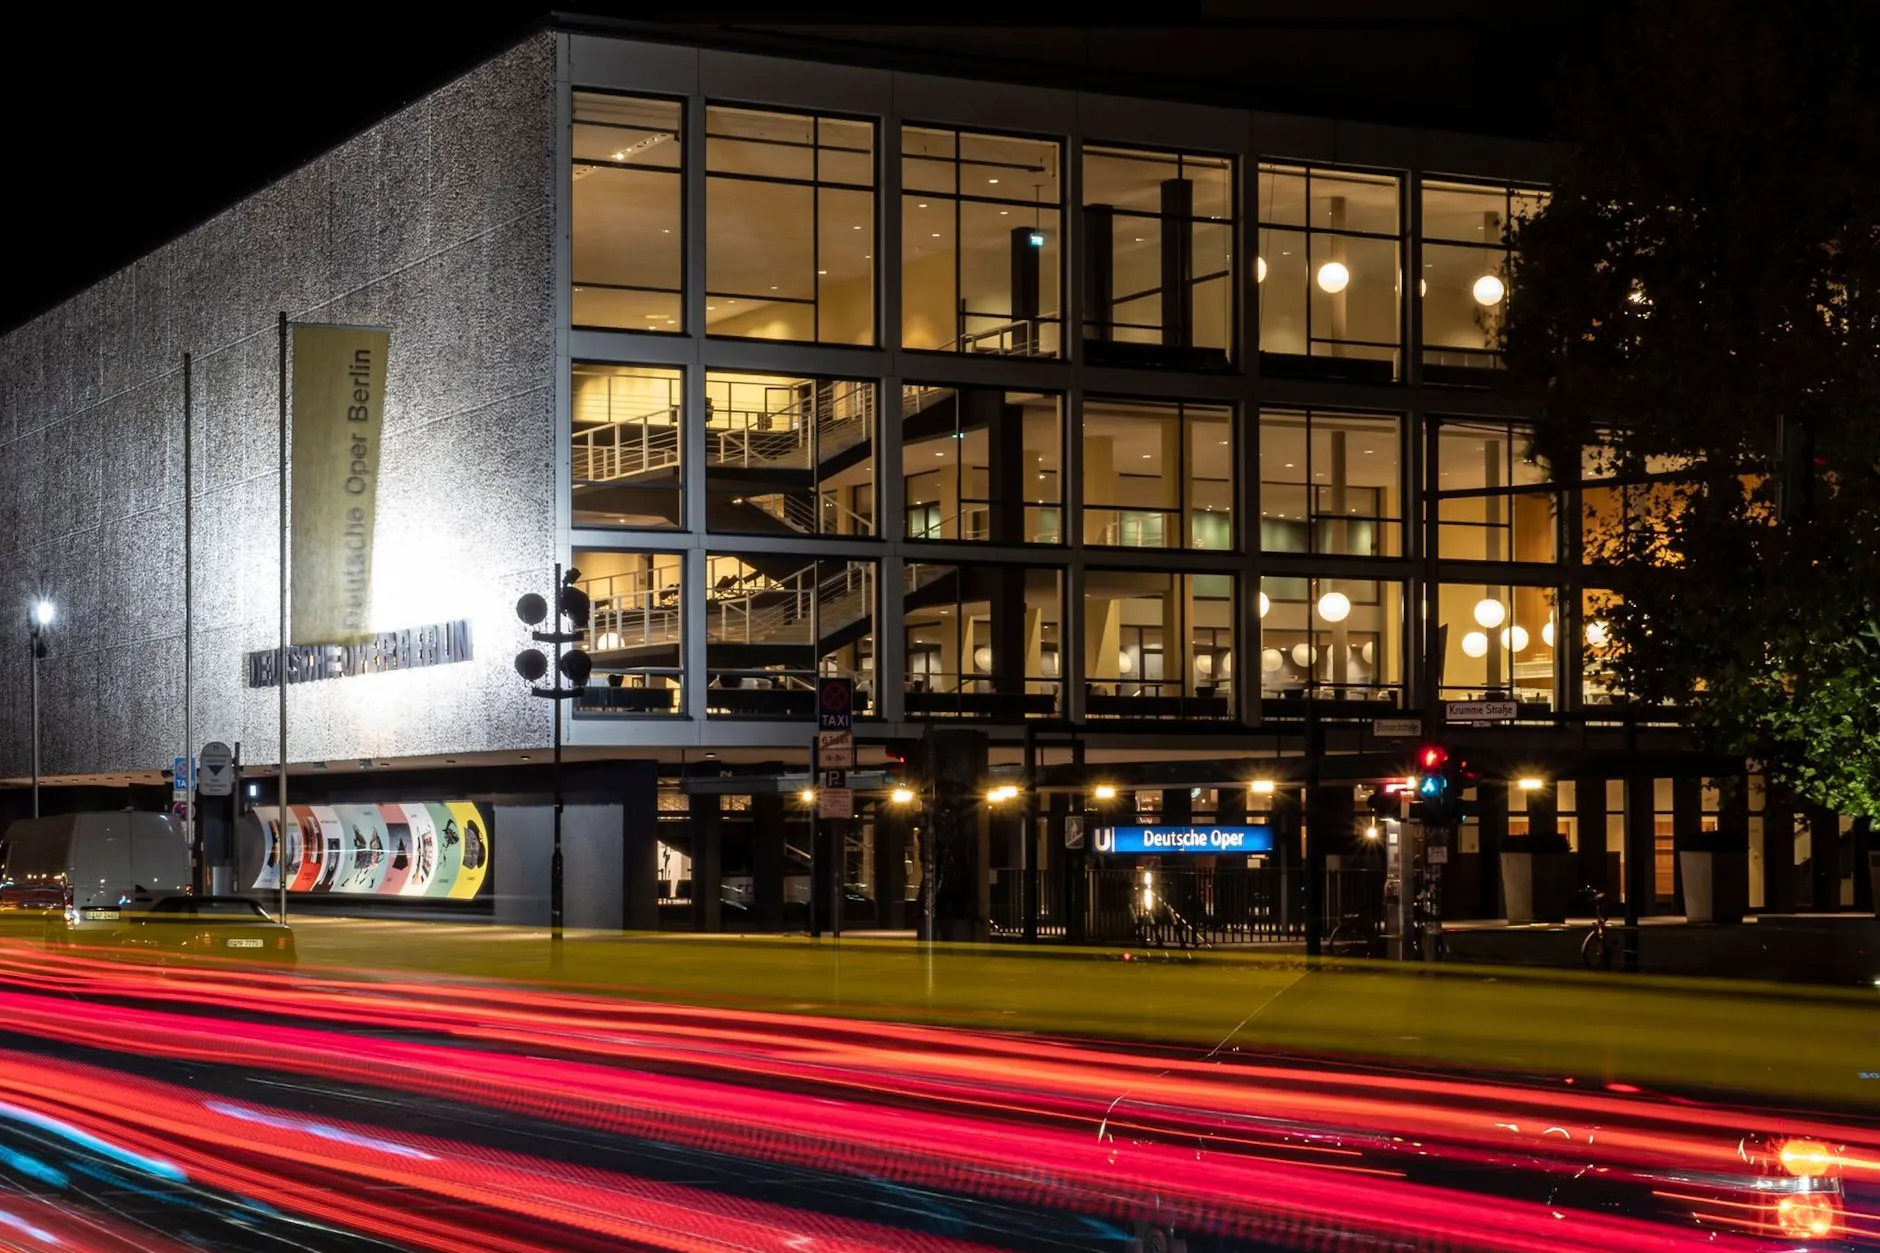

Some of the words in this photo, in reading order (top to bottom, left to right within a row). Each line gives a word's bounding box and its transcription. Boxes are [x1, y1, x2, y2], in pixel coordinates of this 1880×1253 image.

[348, 349, 371, 422] Berlin
[346, 432, 370, 496] Oper
[397, 618, 473, 669] BERLIN
[1450, 704, 1483, 715] Krumme
[1486, 703, 1513, 716] Straße
[822, 714, 849, 727] TAXI
[176, 779, 195, 788] TAI
[828, 770, 840, 787] P
[1094, 828, 1111, 851] U
[1143, 828, 1207, 847] Deutsche
[1210, 829, 1245, 850] Oper
